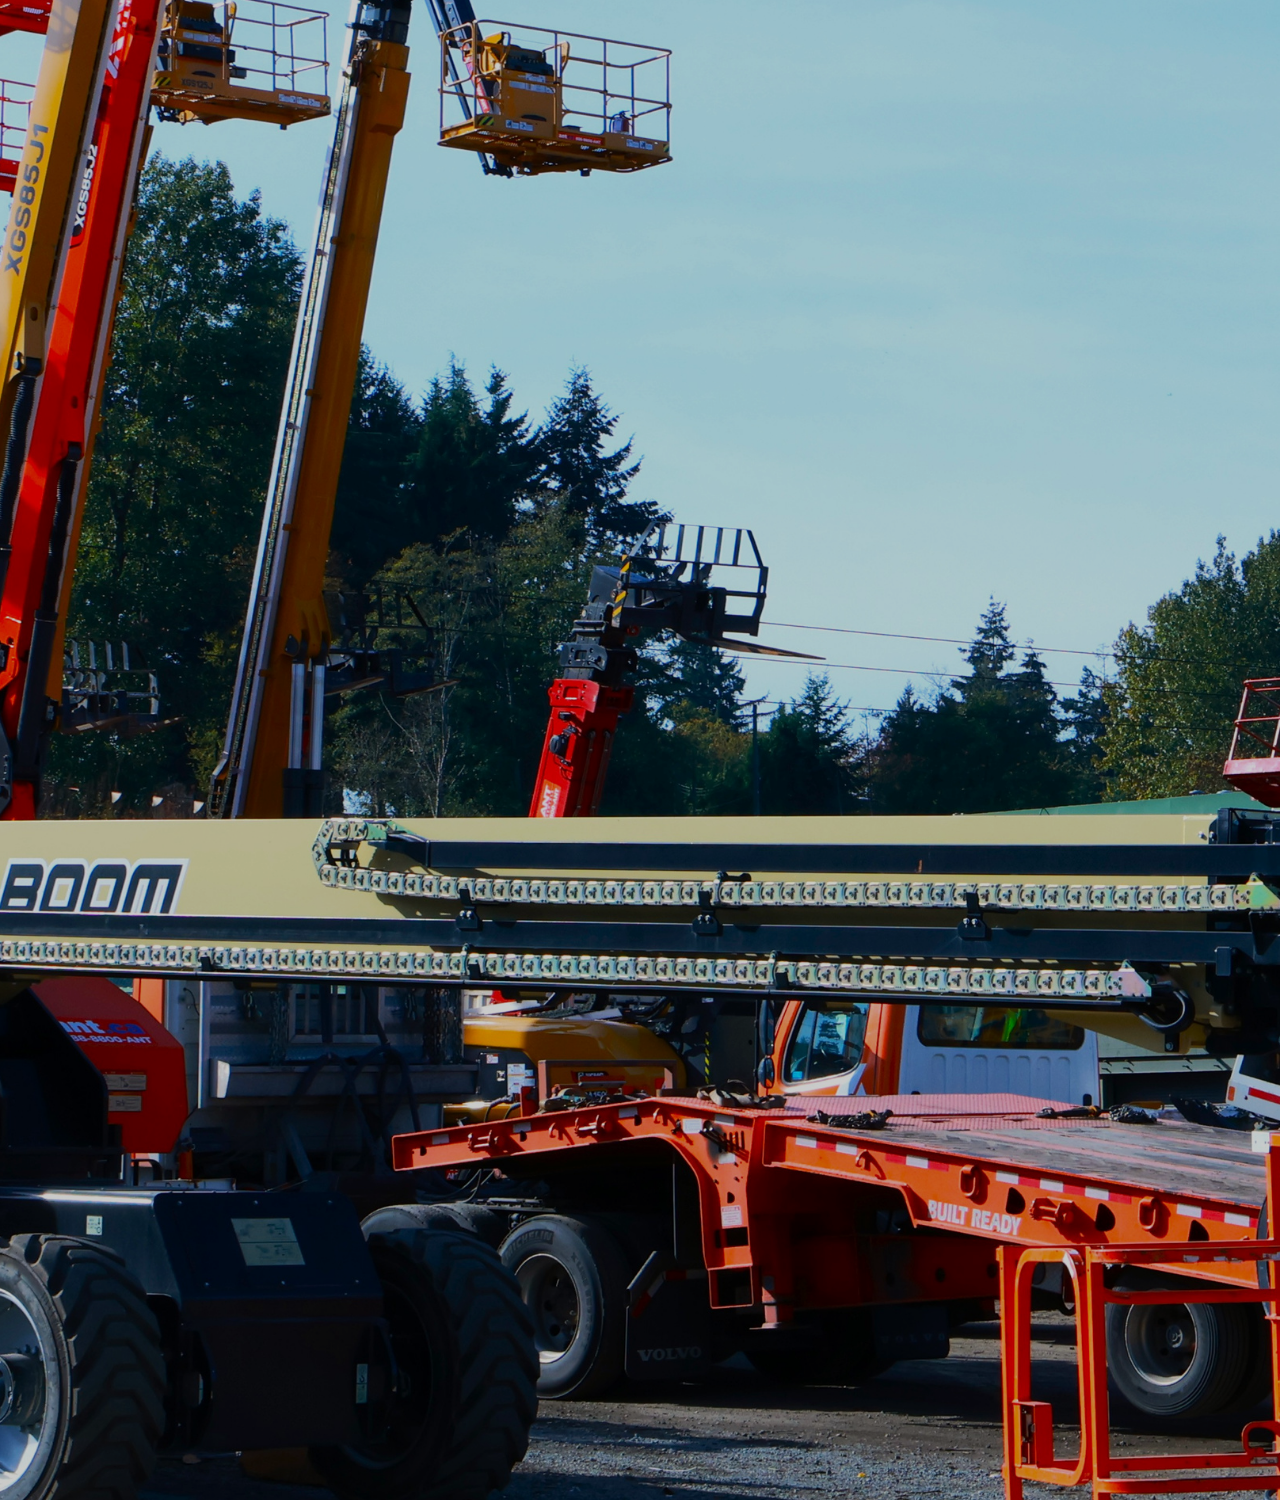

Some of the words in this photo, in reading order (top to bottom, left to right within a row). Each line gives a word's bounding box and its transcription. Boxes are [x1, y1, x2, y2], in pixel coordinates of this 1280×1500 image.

[181, 77, 214, 90] XGS125J
[4, 123, 49, 276] XGS85J1
[73, 144, 98, 229] XGS85J2
[70, 1035, 152, 1044] 88-8800-ANT
[928, 1200, 969, 1225] BUILT
[971, 1208, 1022, 1236] READY
[503, 1230, 553, 1261] MICHELIN
[637, 1346, 702, 1362] VOLVO
